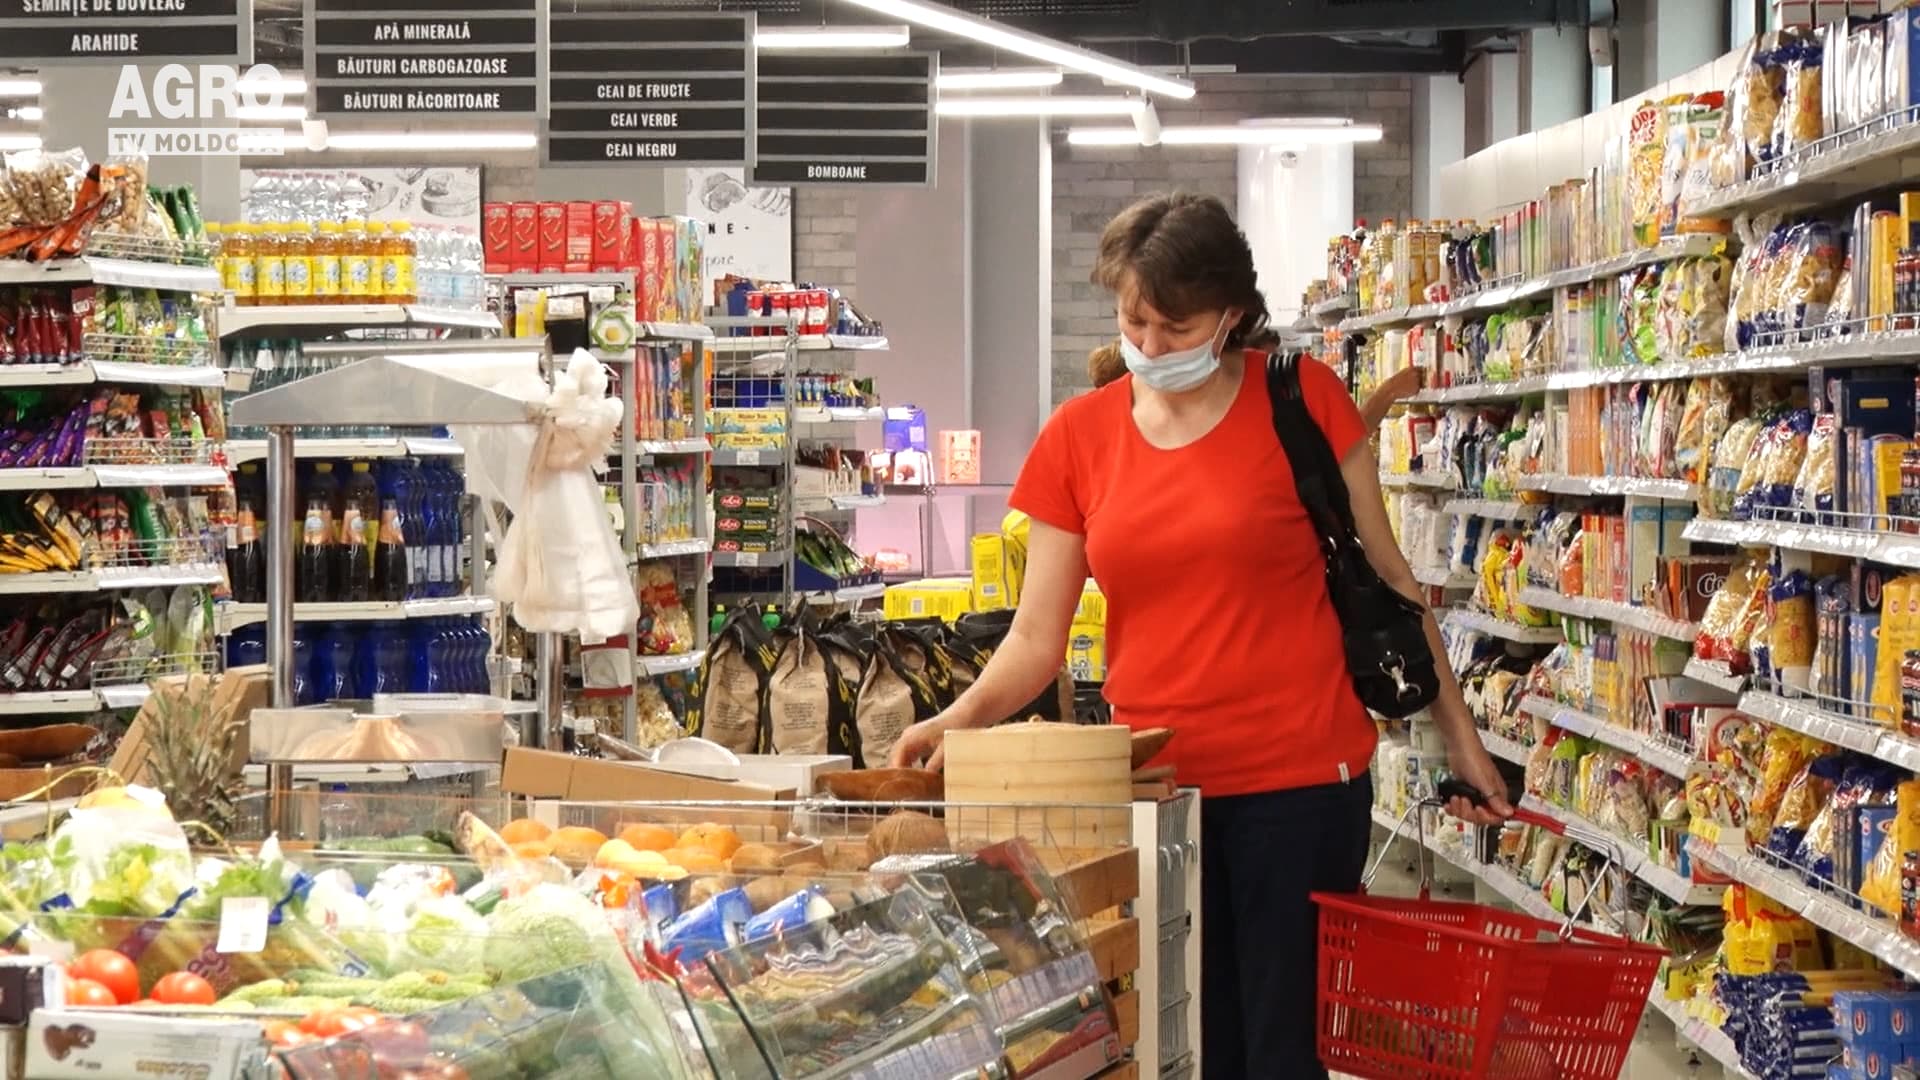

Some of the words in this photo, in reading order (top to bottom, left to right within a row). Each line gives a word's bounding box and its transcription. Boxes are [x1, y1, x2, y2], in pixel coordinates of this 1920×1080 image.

[93, 0, 112, 12] DE
[374, 22, 399, 40] APĂ
[404, 21, 471, 40] MINERALĂ
[71, 33, 138, 51] ARAHIDE
[337, 56, 396, 74] BĂUTURI
[401, 58, 508, 74] CARBOGAZOASE
[597, 85, 624, 98] CEAI
[628, 85, 643, 98] DE
[646, 83, 690, 97] FRUCTE
[344, 91, 402, 109] BĂUTURI
[407, 91, 500, 109] RĂCORITOARE
[610, 113, 638, 127] CEAI
[641, 113, 678, 127] VERDE
[606, 143, 633, 157] CEAI
[637, 143, 676, 157] NEGRU
[807, 165, 867, 178] BOMBOANE
